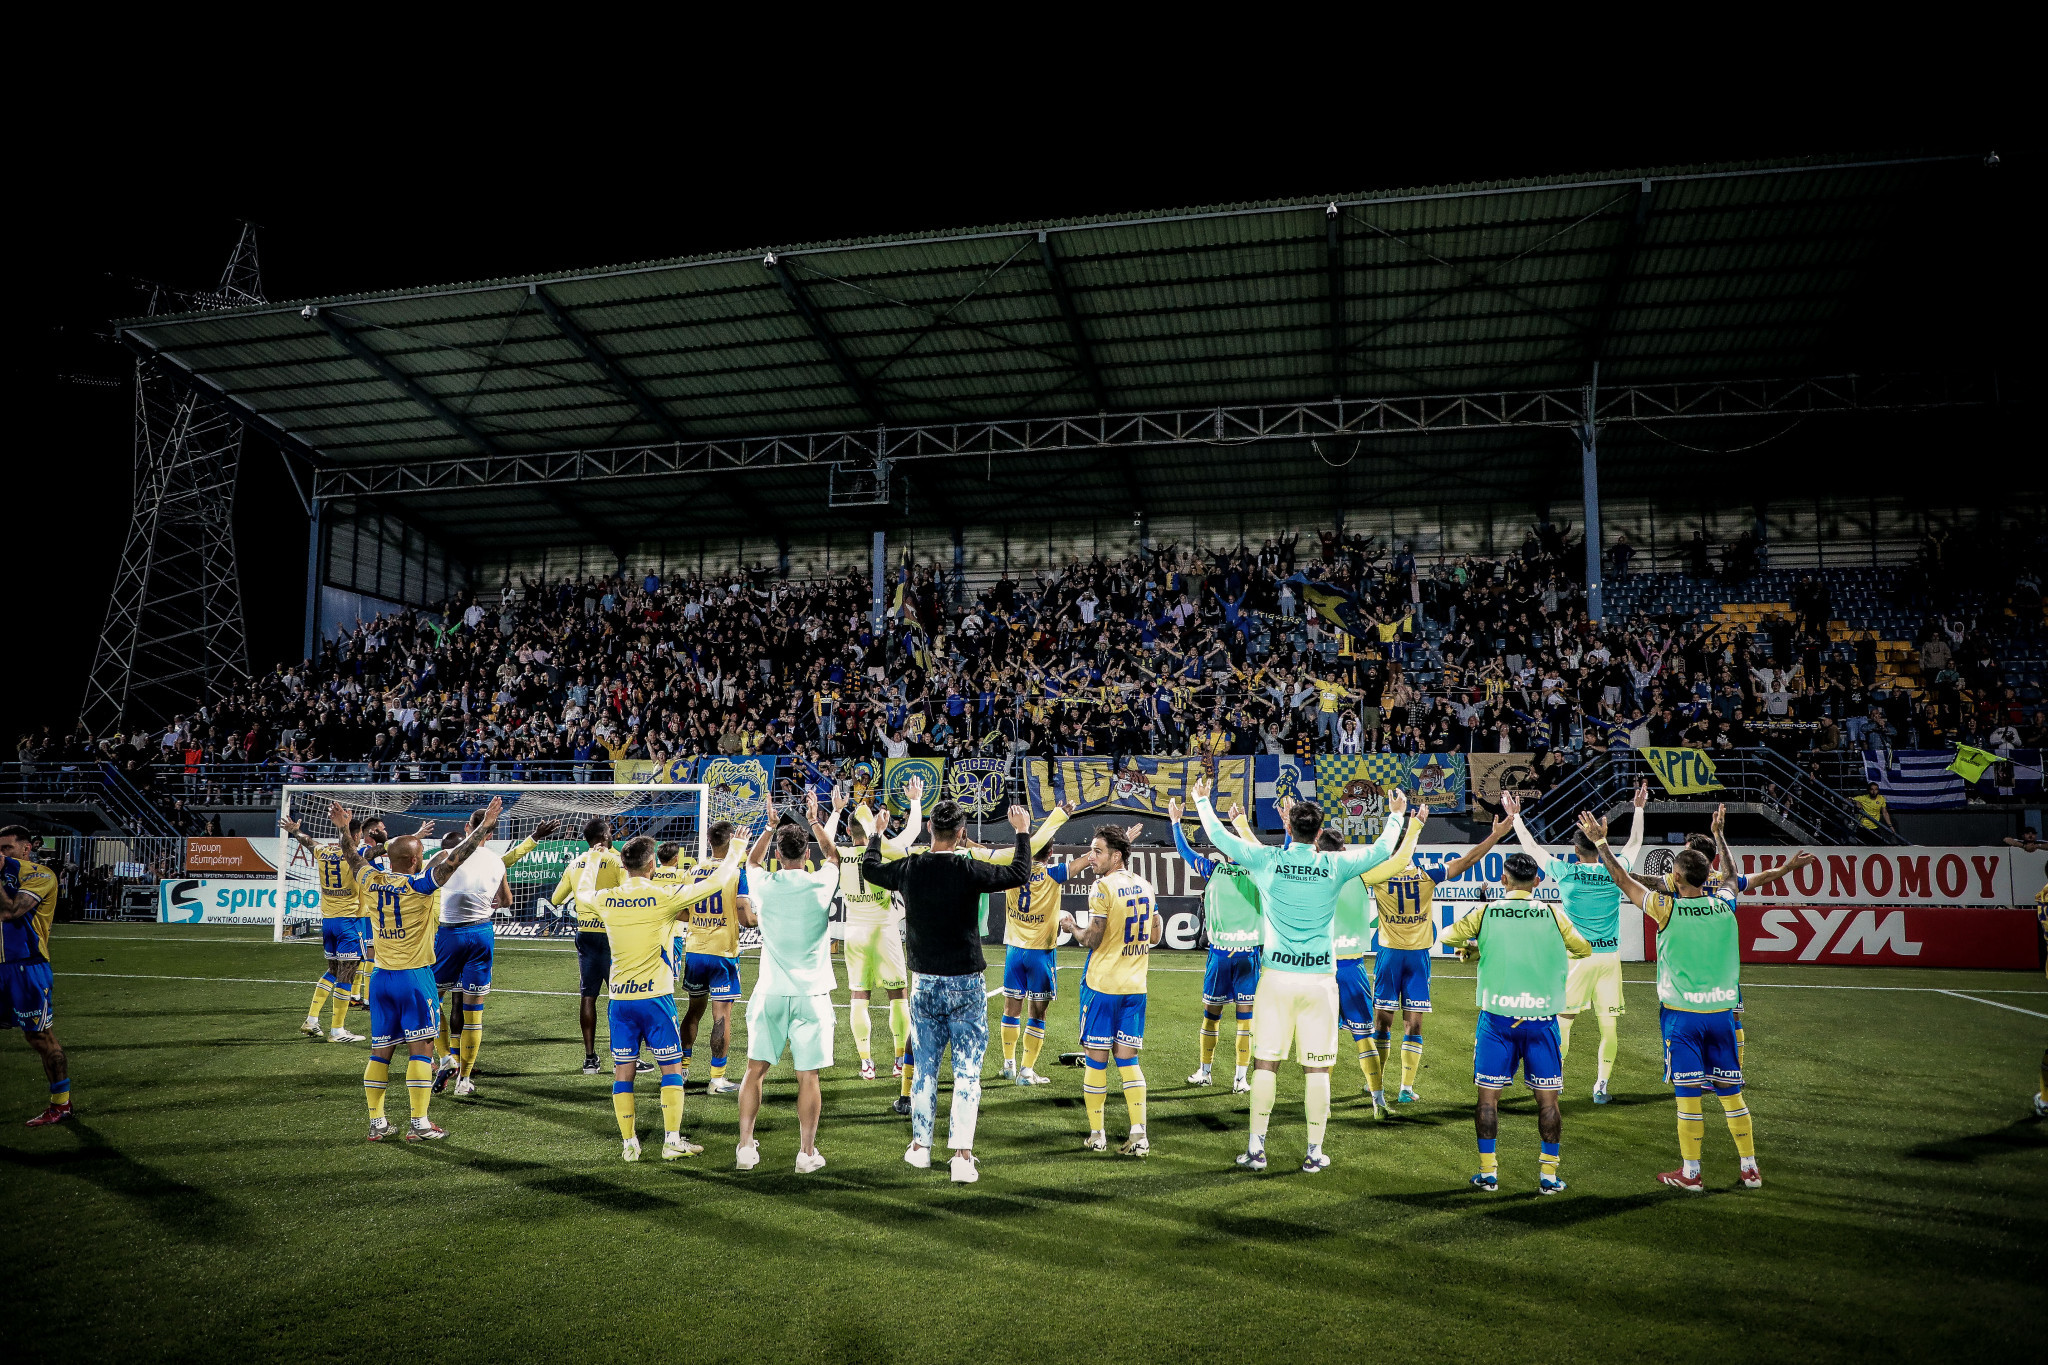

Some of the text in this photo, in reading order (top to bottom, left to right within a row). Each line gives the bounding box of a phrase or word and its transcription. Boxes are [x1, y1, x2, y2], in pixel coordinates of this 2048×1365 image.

[955, 758, 1006, 772] TIGERS
[190, 843, 222, 854] Σίγουρη
[190, 855, 243, 866] εξυπηρέτηση!
[325, 860, 342, 887] 13
[1275, 864, 1329, 878] ASTERAS
[605, 897, 657, 908] macron
[1017, 882, 1032, 914] 8
[1387, 880, 1421, 915] 74
[242, 916, 275, 924] ΘΑΛΑΜΟΙ
[1123, 896, 1150, 944] 22
[1490, 907, 1550, 919] macron
[379, 928, 406, 939] ALHO
[1751, 909, 1923, 961] SYM
[1271, 951, 1331, 967] novibet
